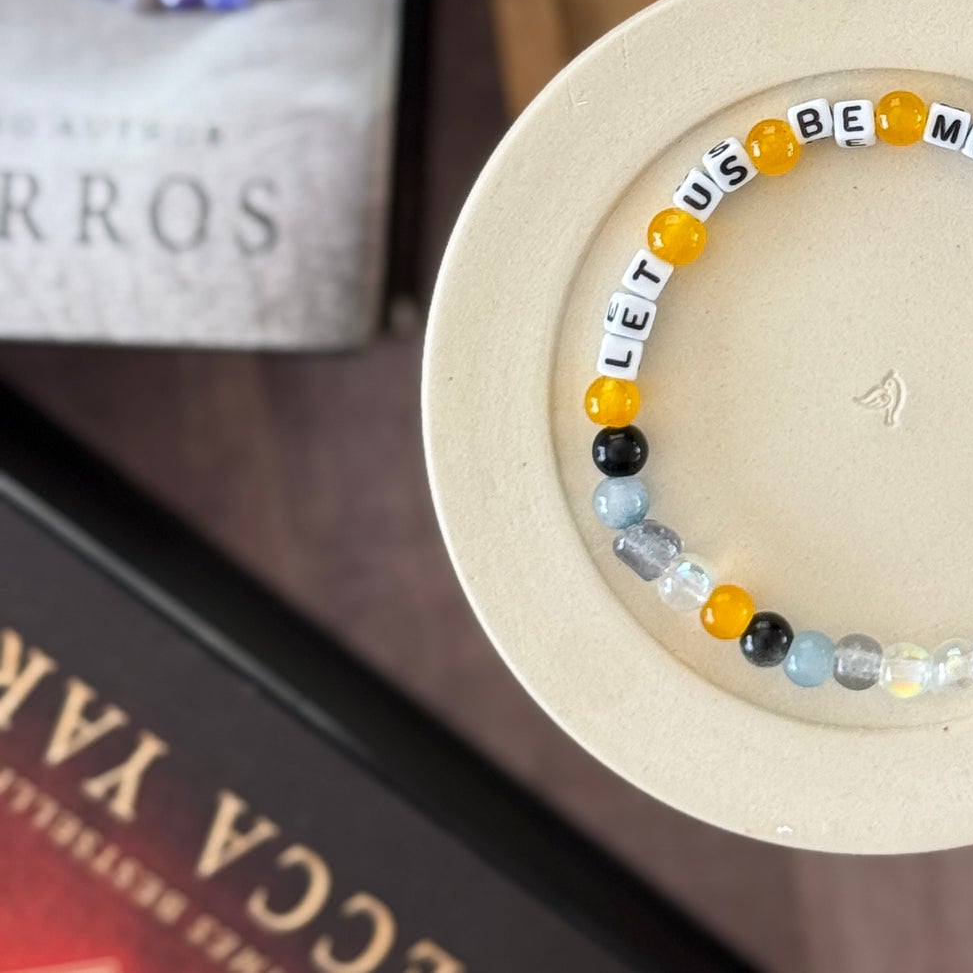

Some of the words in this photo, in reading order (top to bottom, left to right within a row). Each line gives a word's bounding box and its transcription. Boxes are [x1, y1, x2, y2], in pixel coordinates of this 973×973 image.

[604, 258, 662, 369] LET
[682, 153, 749, 212] US
[795, 104, 866, 140] BE
